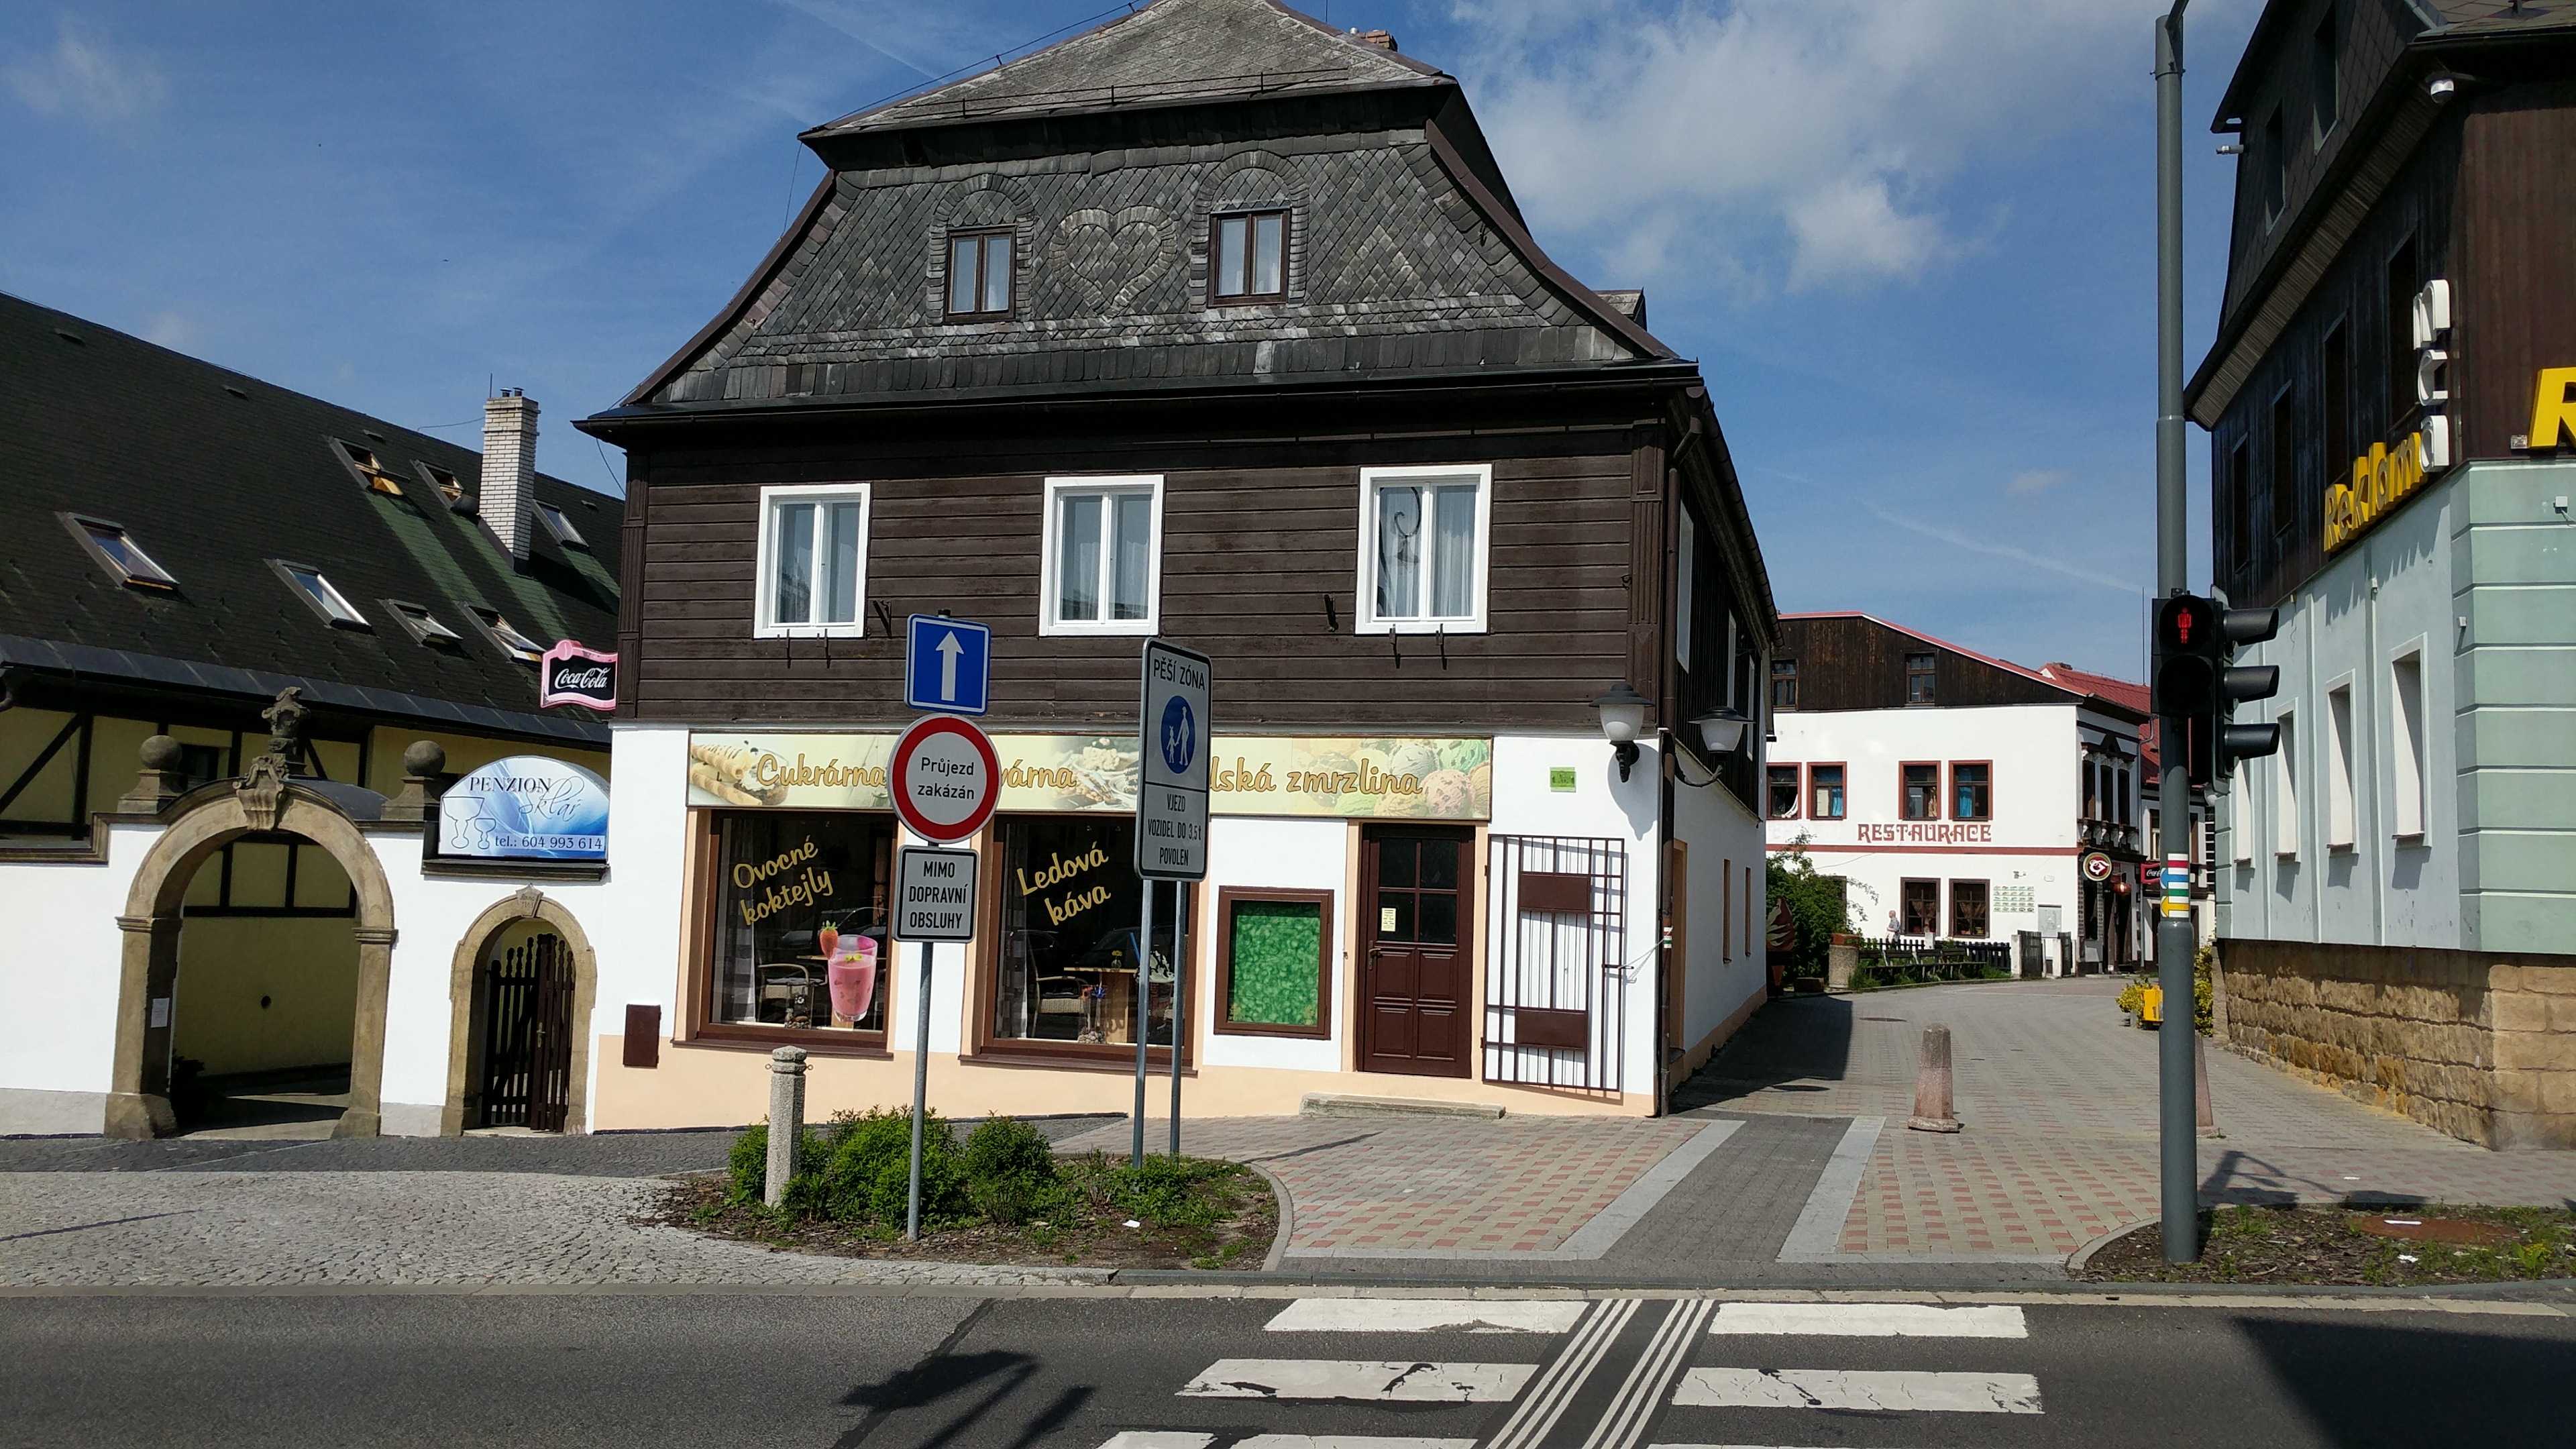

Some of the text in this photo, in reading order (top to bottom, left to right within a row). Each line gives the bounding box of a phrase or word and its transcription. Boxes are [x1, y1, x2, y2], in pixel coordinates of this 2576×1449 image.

[2324, 432, 2423, 552] Reklam
[1153, 656, 1205, 691] PĚŠÍ ZÓNA
[757, 753, 1423, 795] Cukrárna árna lská zmrzlina
[921, 757, 974, 776] Průjezd
[470, 777, 551, 792] PENZION
[918, 782, 974, 800] zakázán
[1167, 794, 1185, 812] VJEZD
[1148, 818, 1175, 838] VOZIDEL
[1177, 822, 1186, 839] DO
[1858, 824, 1992, 844] RESTAURACE
[495, 836, 602, 849] tel.: 604 993 614
[734, 835, 818, 889] Ovocné
[1159, 847, 1189, 866] POVOLEN
[923, 861, 955, 878] MIMO
[1017, 841, 1109, 896] Ledová
[740, 867, 833, 926] koktejly
[909, 883, 969, 904] DOPRAVNÍ
[1044, 884, 1112, 926] káva
[910, 912, 963, 930] OBSLUHY
